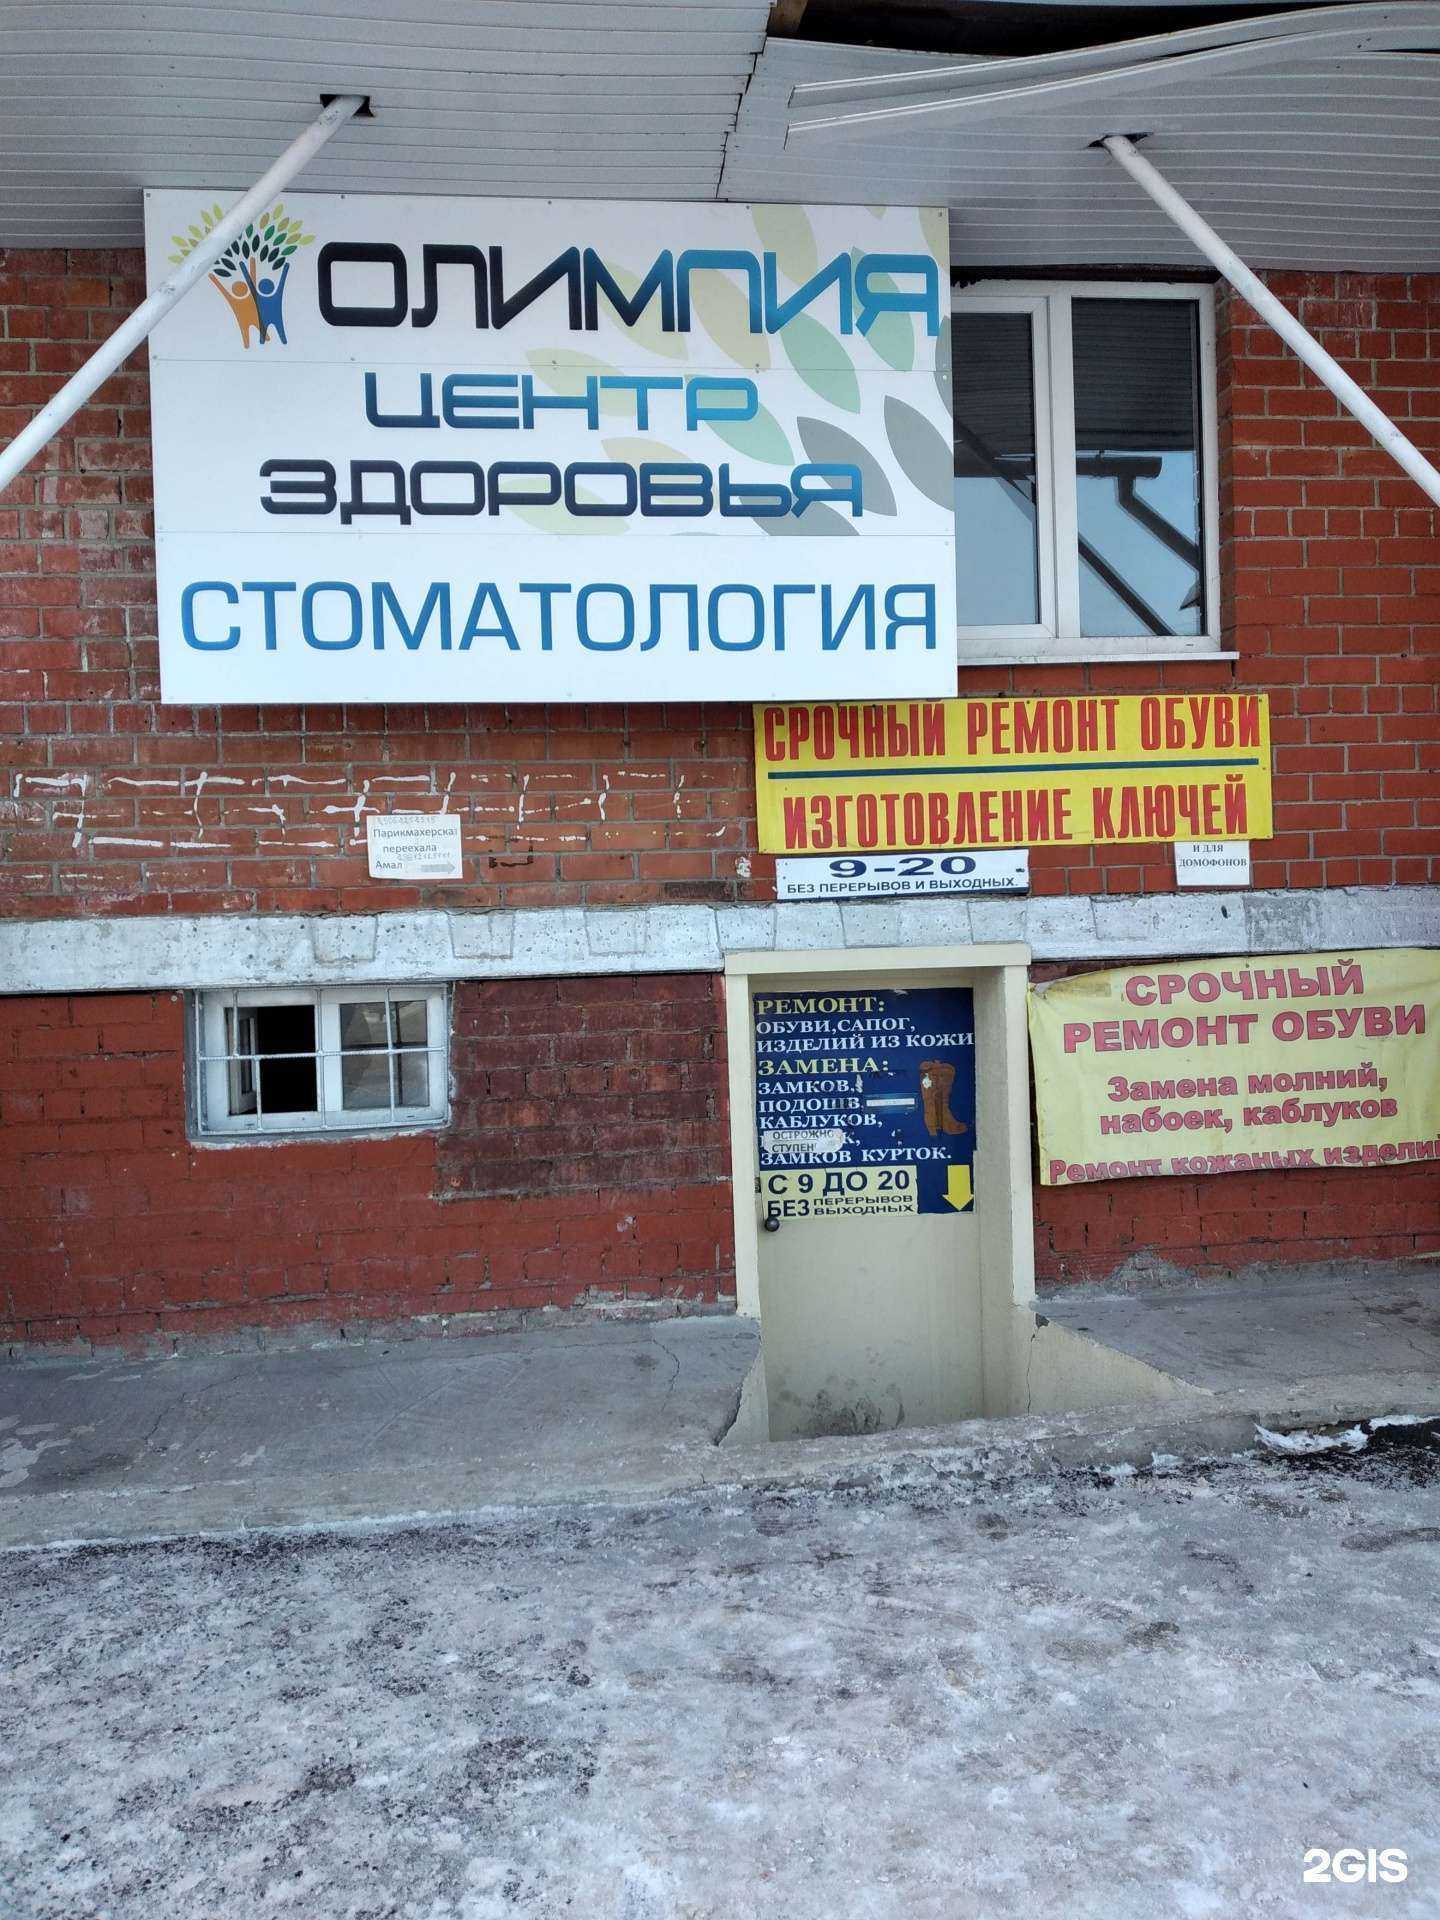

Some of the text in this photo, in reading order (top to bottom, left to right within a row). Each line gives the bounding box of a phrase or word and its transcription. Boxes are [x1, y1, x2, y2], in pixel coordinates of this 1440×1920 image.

[317, 241, 940, 337] ОЛИМПИЯ
[364, 371, 758, 431] ЦЕНТР
[260, 458, 863, 525] ЗДОРОВЬЯ
[180, 580, 937, 651] СТОМАТОЛОГИЯ
[765, 694, 1261, 761] СРОЧНЫЙ РЕМОНТ ОБУВИ
[784, 773, 1248, 850] ИЗГОТОВЛЕНИЕ КЛЮЧЕЙ
[373, 827, 458, 839] Парикмахерска
[383, 844, 437, 854] переехала
[1203, 844, 1224, 853] ДЛЯ
[829, 856, 976, 878] 9-20
[1179, 858, 1247, 867] ДОМОФОНОВ
[787, 884, 815, 894] БЕЗ
[819, 881, 911, 893] ПЕРЕРЫВОВ
[915, 881, 926, 890] И
[1125, 958, 1365, 1006] СРОЧНЫЙ
[756, 997, 885, 1015] РЕМОНТ:
[1063, 1004, 1426, 1054] РЕМОНТ ОБУВИ
[756, 1033, 974, 1053] ИЗДЕЛИЙ ИЗ КОЖИ
[758, 1058, 889, 1076] ЗАМЕНА:
[1107, 1061, 1389, 1102] Замена молний,
[759, 1113, 883, 1129] КАБЛУКОВ,
[1100, 1098, 1399, 1135] набоек, каблуков
[761, 1148, 952, 1165] ЗАМКОВ КУРТОК.
[1049, 1158, 1162, 1184] Ремонт
[1171, 1147, 1314, 1174] кожаных
[768, 1169, 910, 1196] С 9 ДО 20
[767, 1195, 913, 1217] БЕЗ ПЕРЕРЫВОВ
[814, 1204, 914, 1216] ВЫХОДНЫХ
